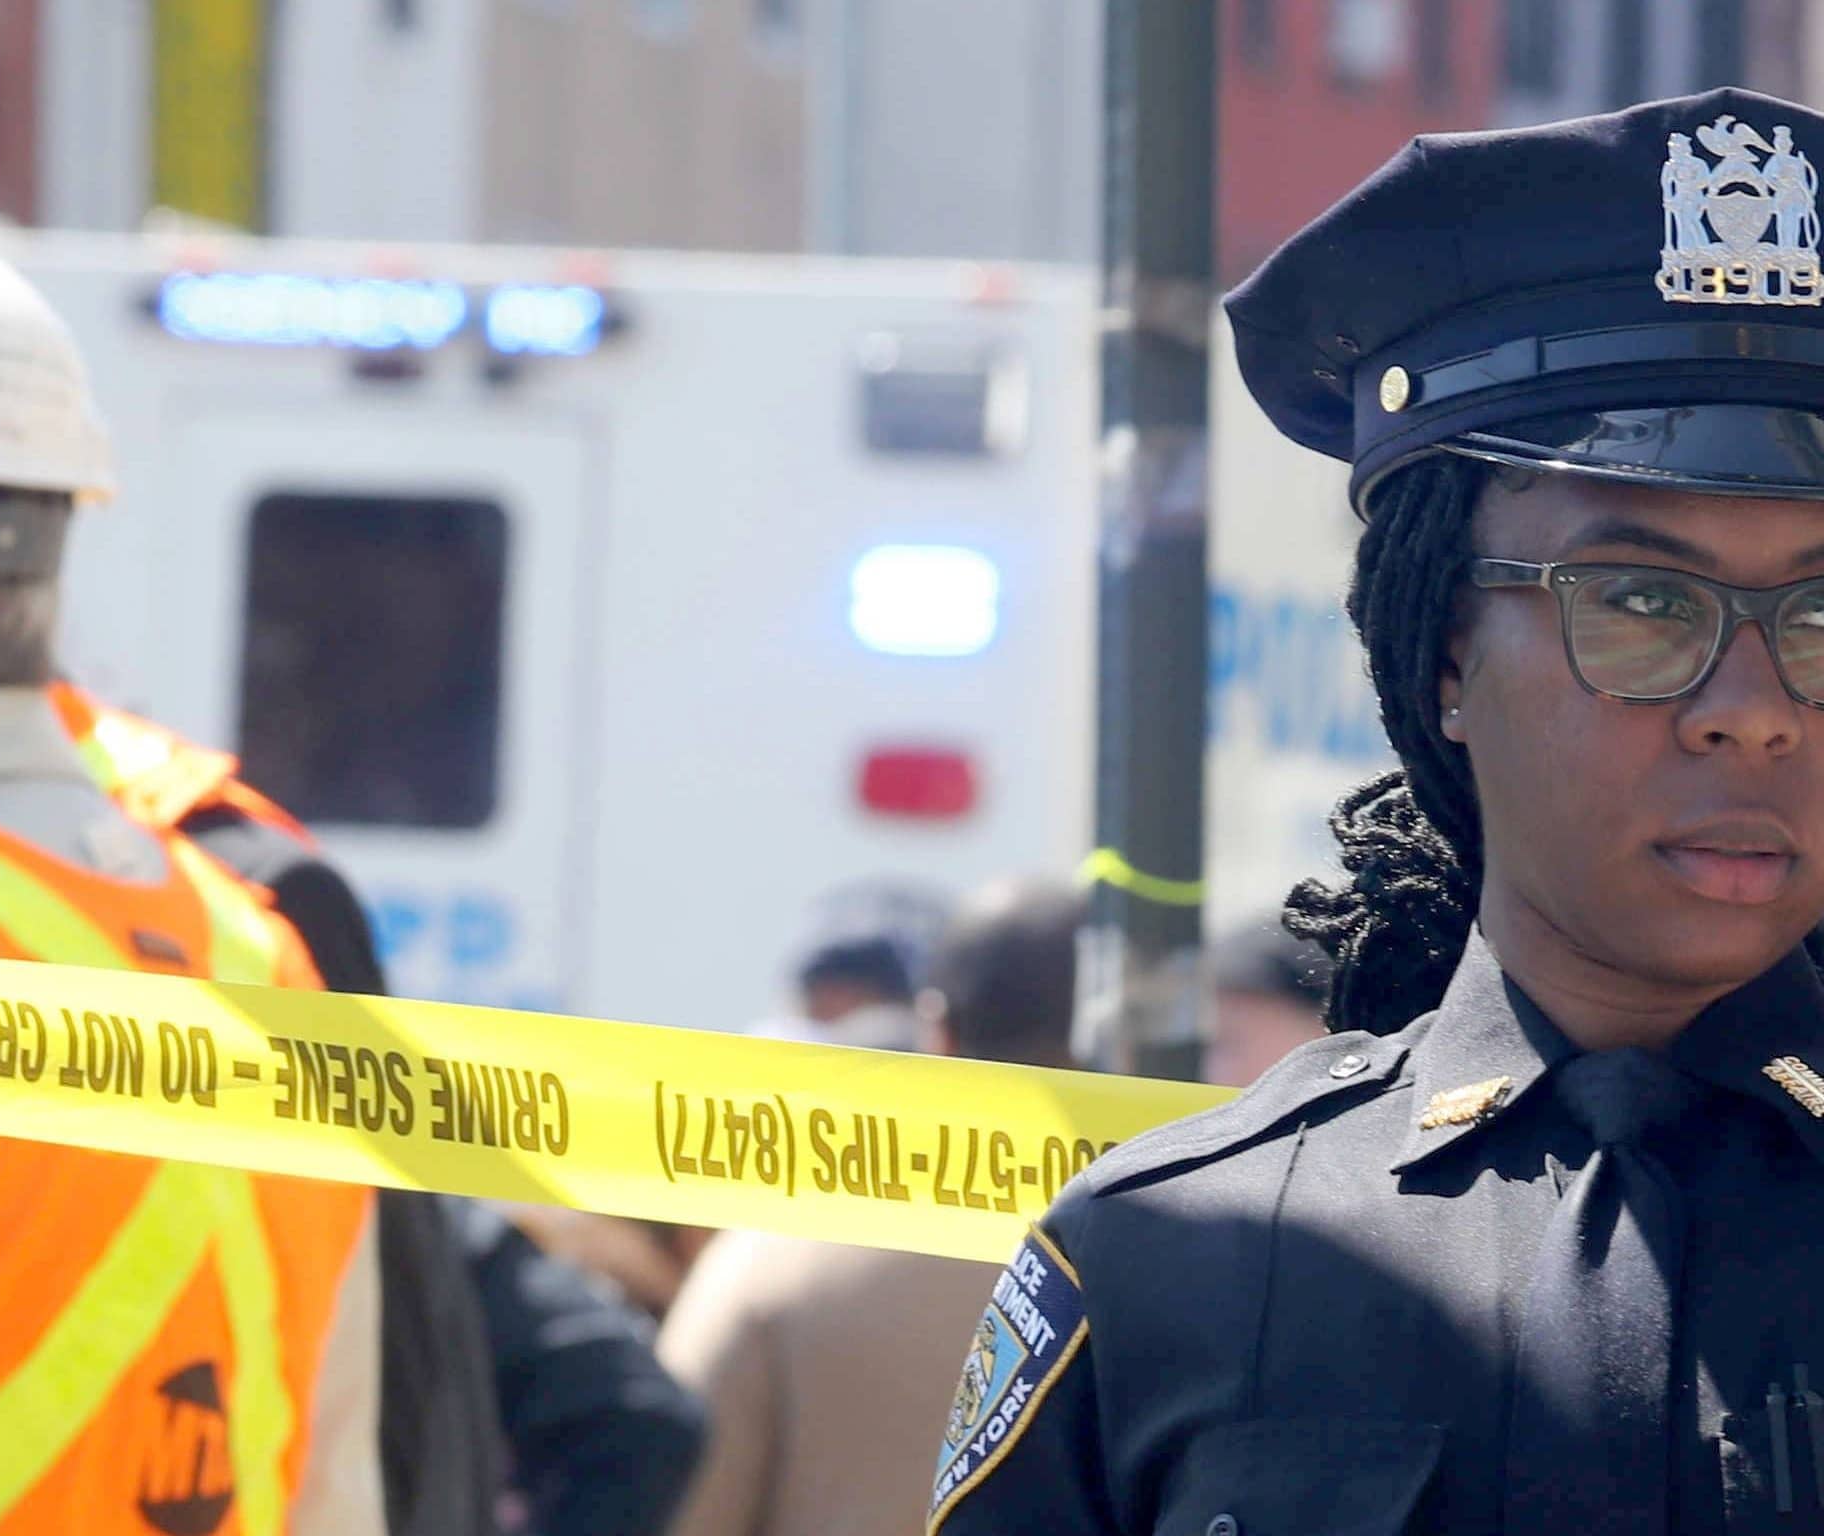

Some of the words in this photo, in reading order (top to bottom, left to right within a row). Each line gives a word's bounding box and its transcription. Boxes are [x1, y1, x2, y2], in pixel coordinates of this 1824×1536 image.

[59, 1009, 143, 1096] NOT
[160, 1021, 217, 1108] DO
[268, 1035, 415, 1136] SCENE
[425, 1056, 569, 1156] CRIME
[655, 1081, 796, 1197] (8477)
[971, 1376, 1036, 1457] YORK
